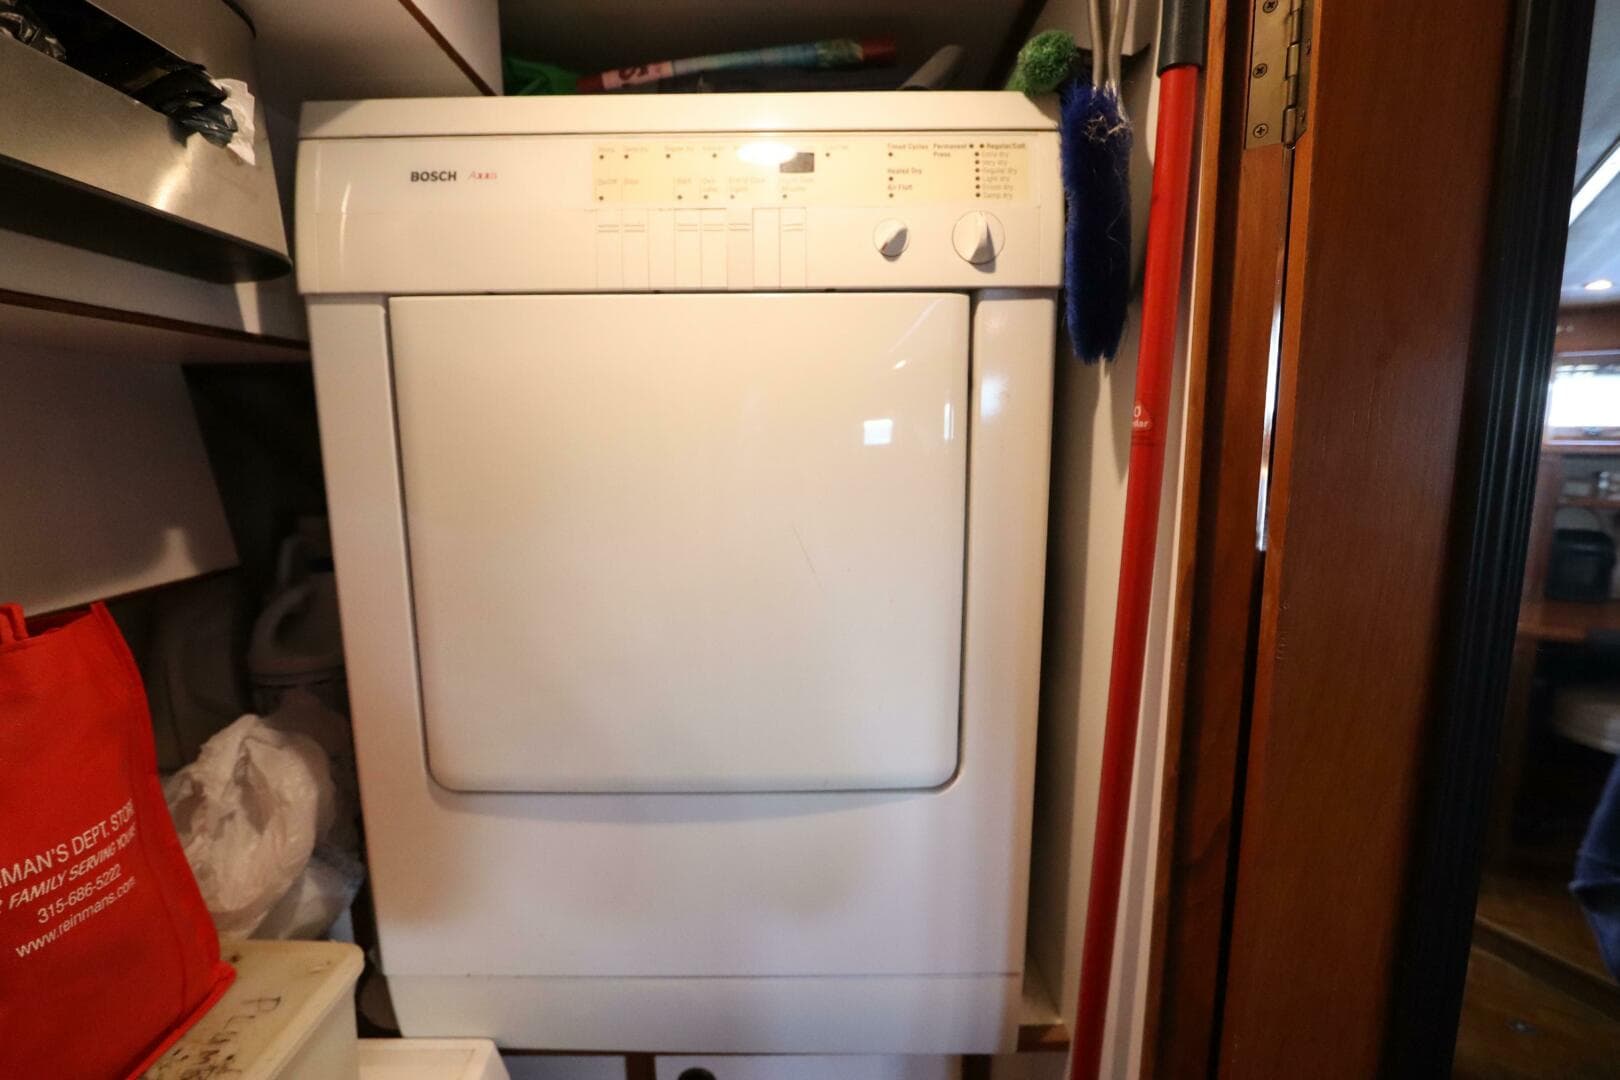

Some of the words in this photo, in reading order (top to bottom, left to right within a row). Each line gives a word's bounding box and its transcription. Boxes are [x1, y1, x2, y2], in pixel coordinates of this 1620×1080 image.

[410, 171, 457, 182] BOSCH
[0, 843, 69, 888] MAN'S
[72, 820, 110, 856] DEPT.
[110, 798, 136, 831] STOR
[8, 870, 68, 910] FAMILY
[69, 841, 117, 881] SERVING
[16, 875, 136, 958] www.reinmans.com
[37, 863, 122, 923] 315-686-5222
